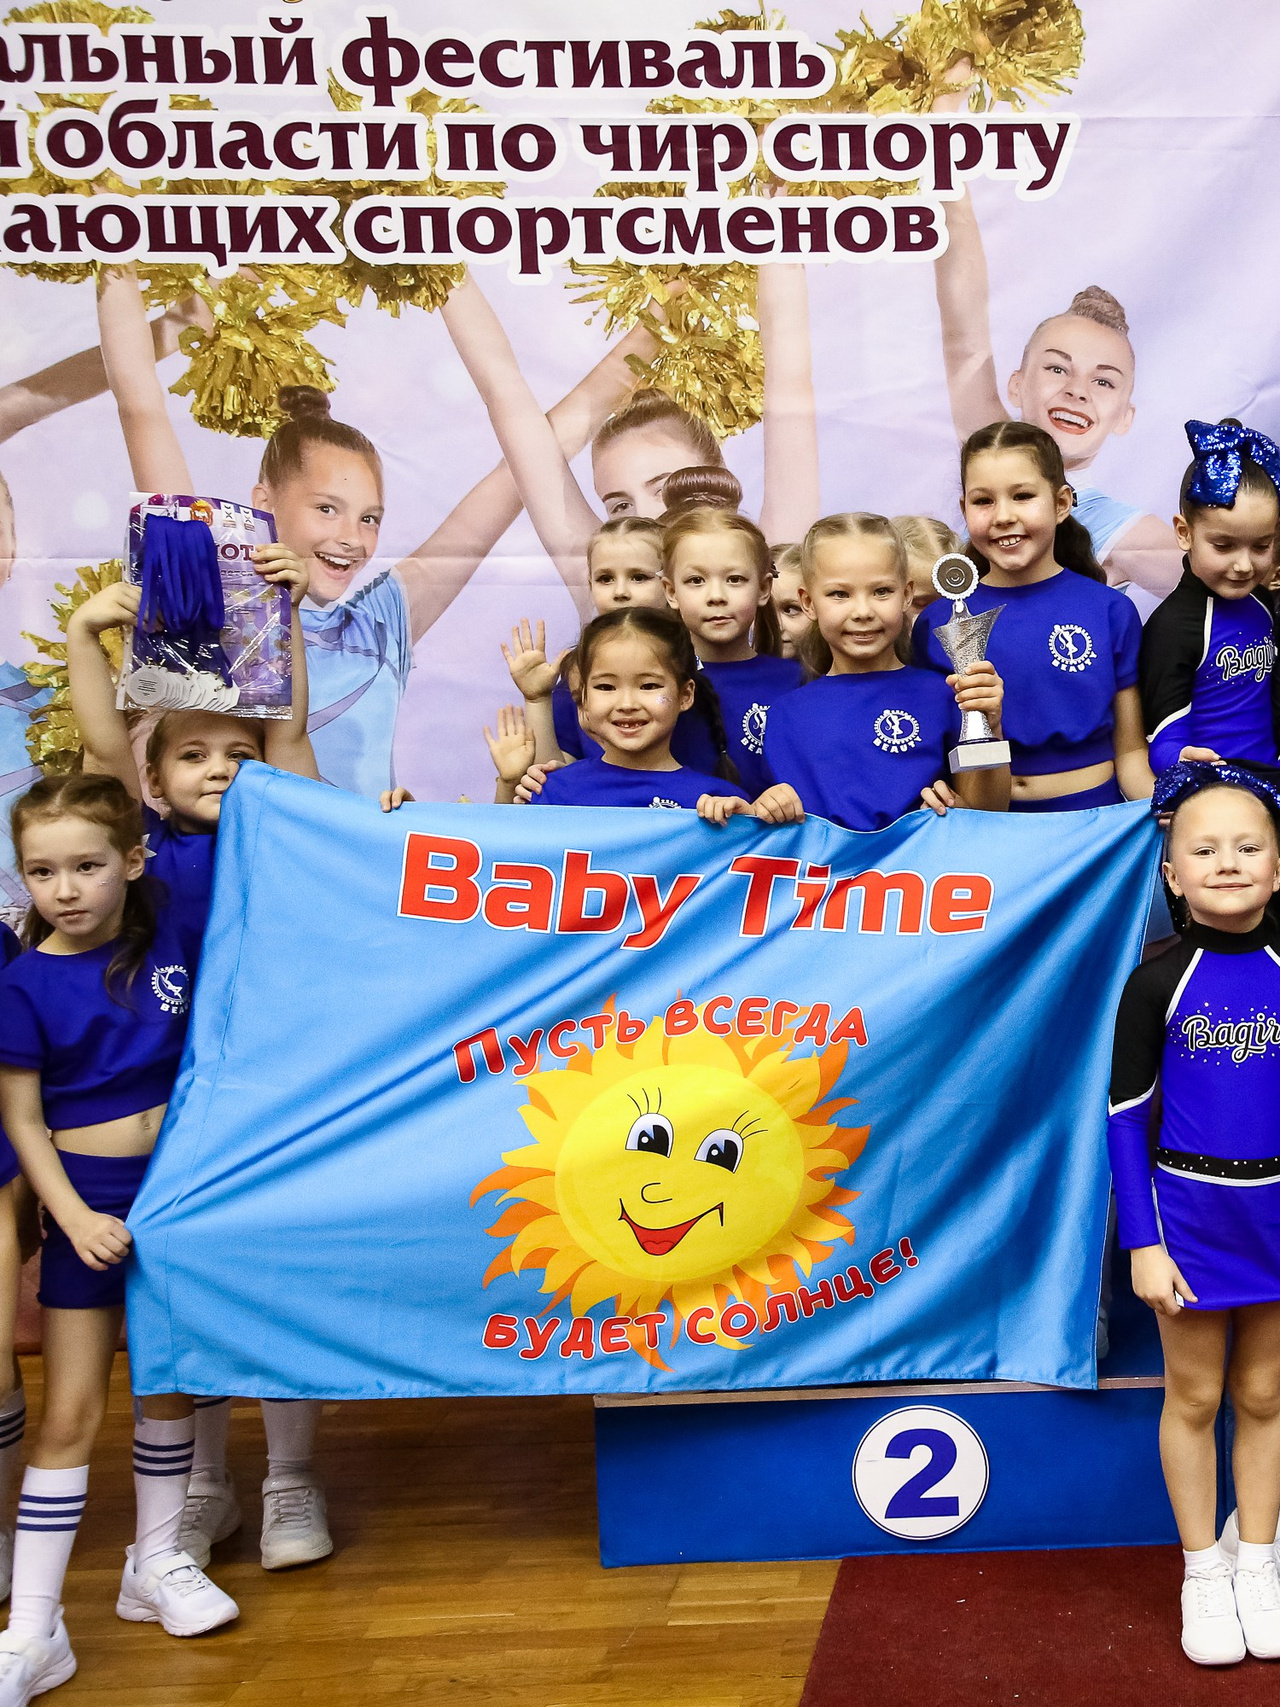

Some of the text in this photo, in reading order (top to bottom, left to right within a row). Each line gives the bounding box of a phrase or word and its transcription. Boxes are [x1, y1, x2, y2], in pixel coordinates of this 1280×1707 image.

[341, 16, 826, 107] фестиваль
[46, 98, 420, 170] области
[444, 123, 557, 171] по
[581, 124, 748, 192] чир
[773, 122, 1071, 191] спорту
[3, 204, 940, 281] ающих спортсменов
[1052, 651, 1097, 672] BEAUTY
[1216, 636, 1278, 682] Bagi
[873, 736, 922, 753] BEAUTY
[398, 831, 995, 950] Baby Time
[665, 996, 869, 1047] ВСЕГДА
[482, 1237, 919, 1360] БУДЕТ СОЛНЦЕ!
[884, 1427, 960, 1519] 2
